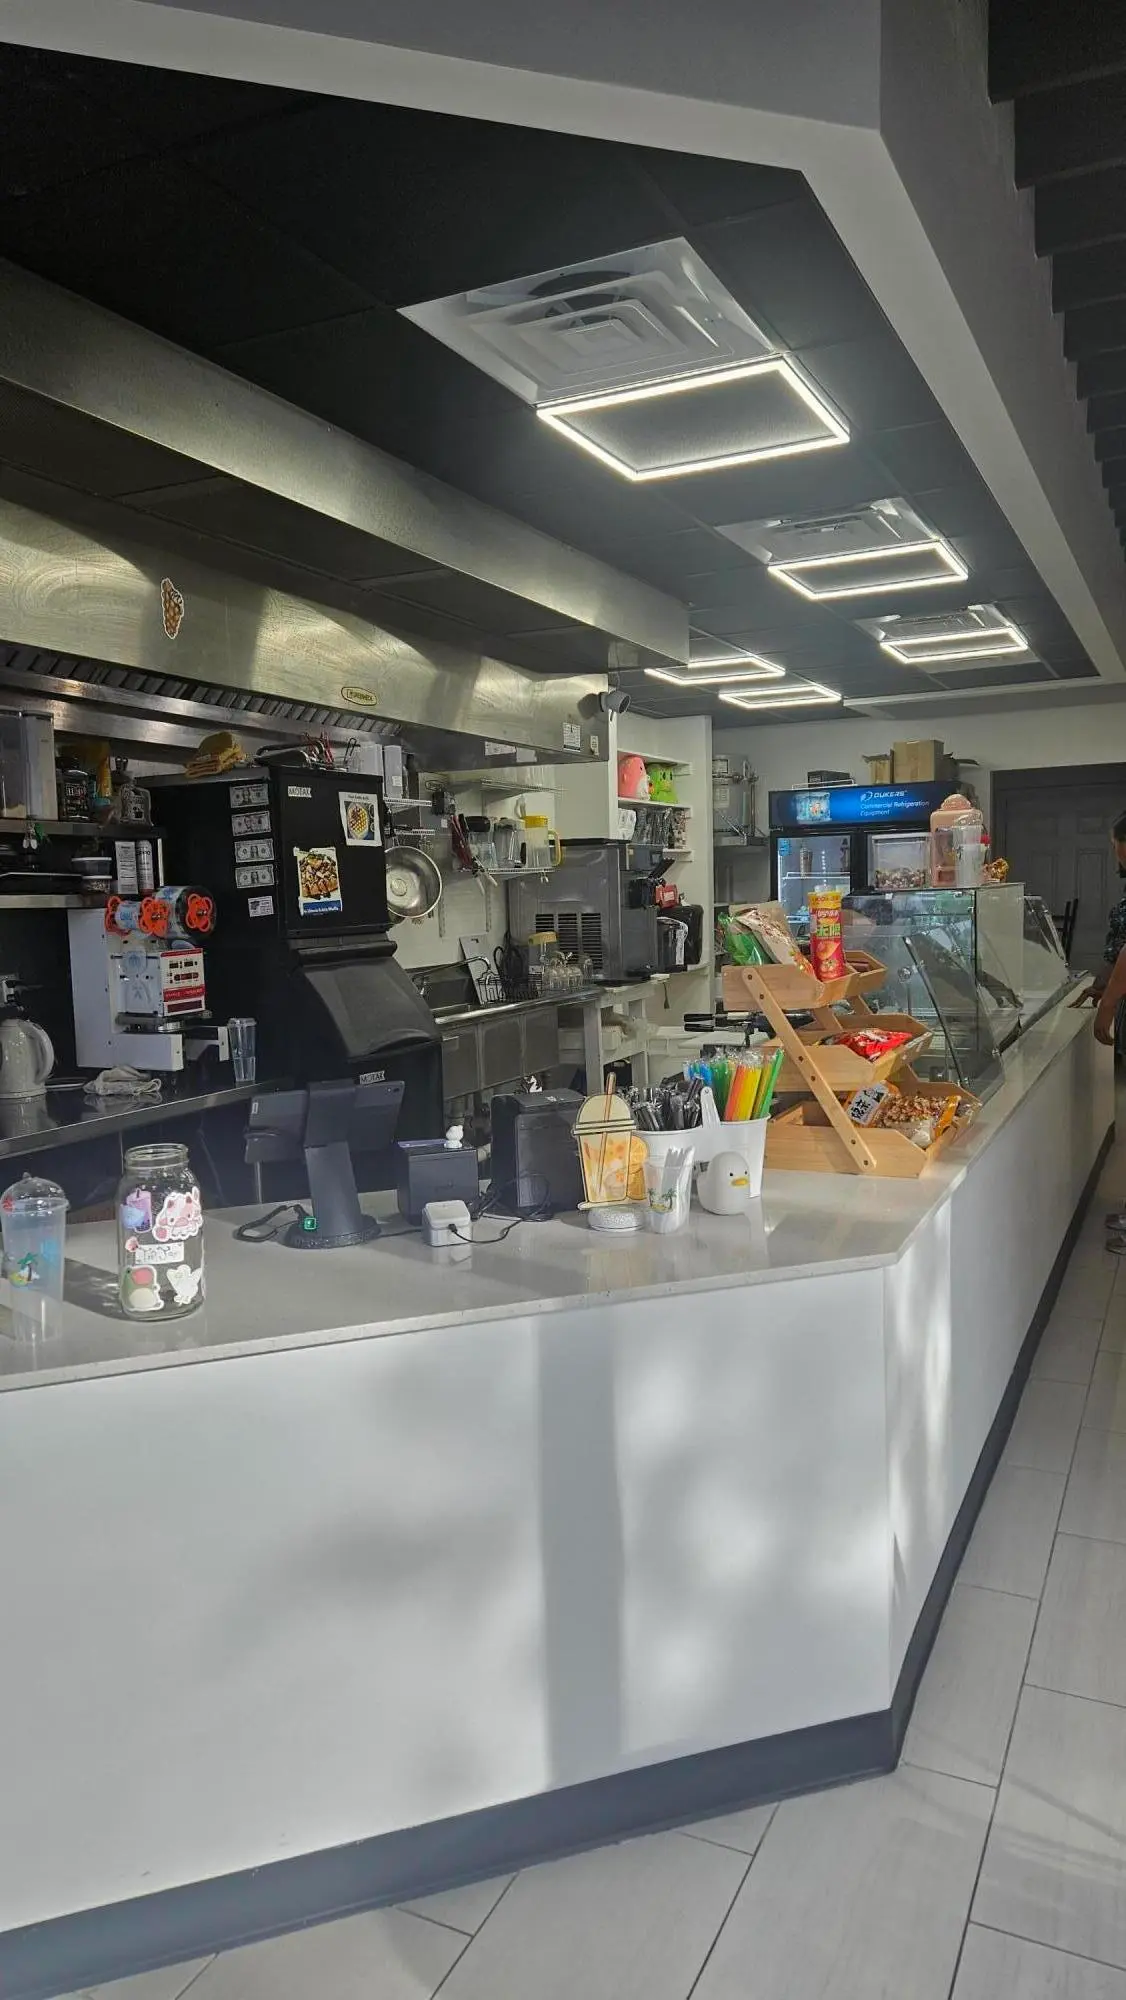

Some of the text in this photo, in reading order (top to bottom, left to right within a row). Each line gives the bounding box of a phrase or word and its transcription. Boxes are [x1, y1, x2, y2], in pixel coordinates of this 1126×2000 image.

[873, 790, 905, 798] DUKERS
[893, 800, 930, 809] Refrigeration
[860, 809, 890, 817] Equipment
